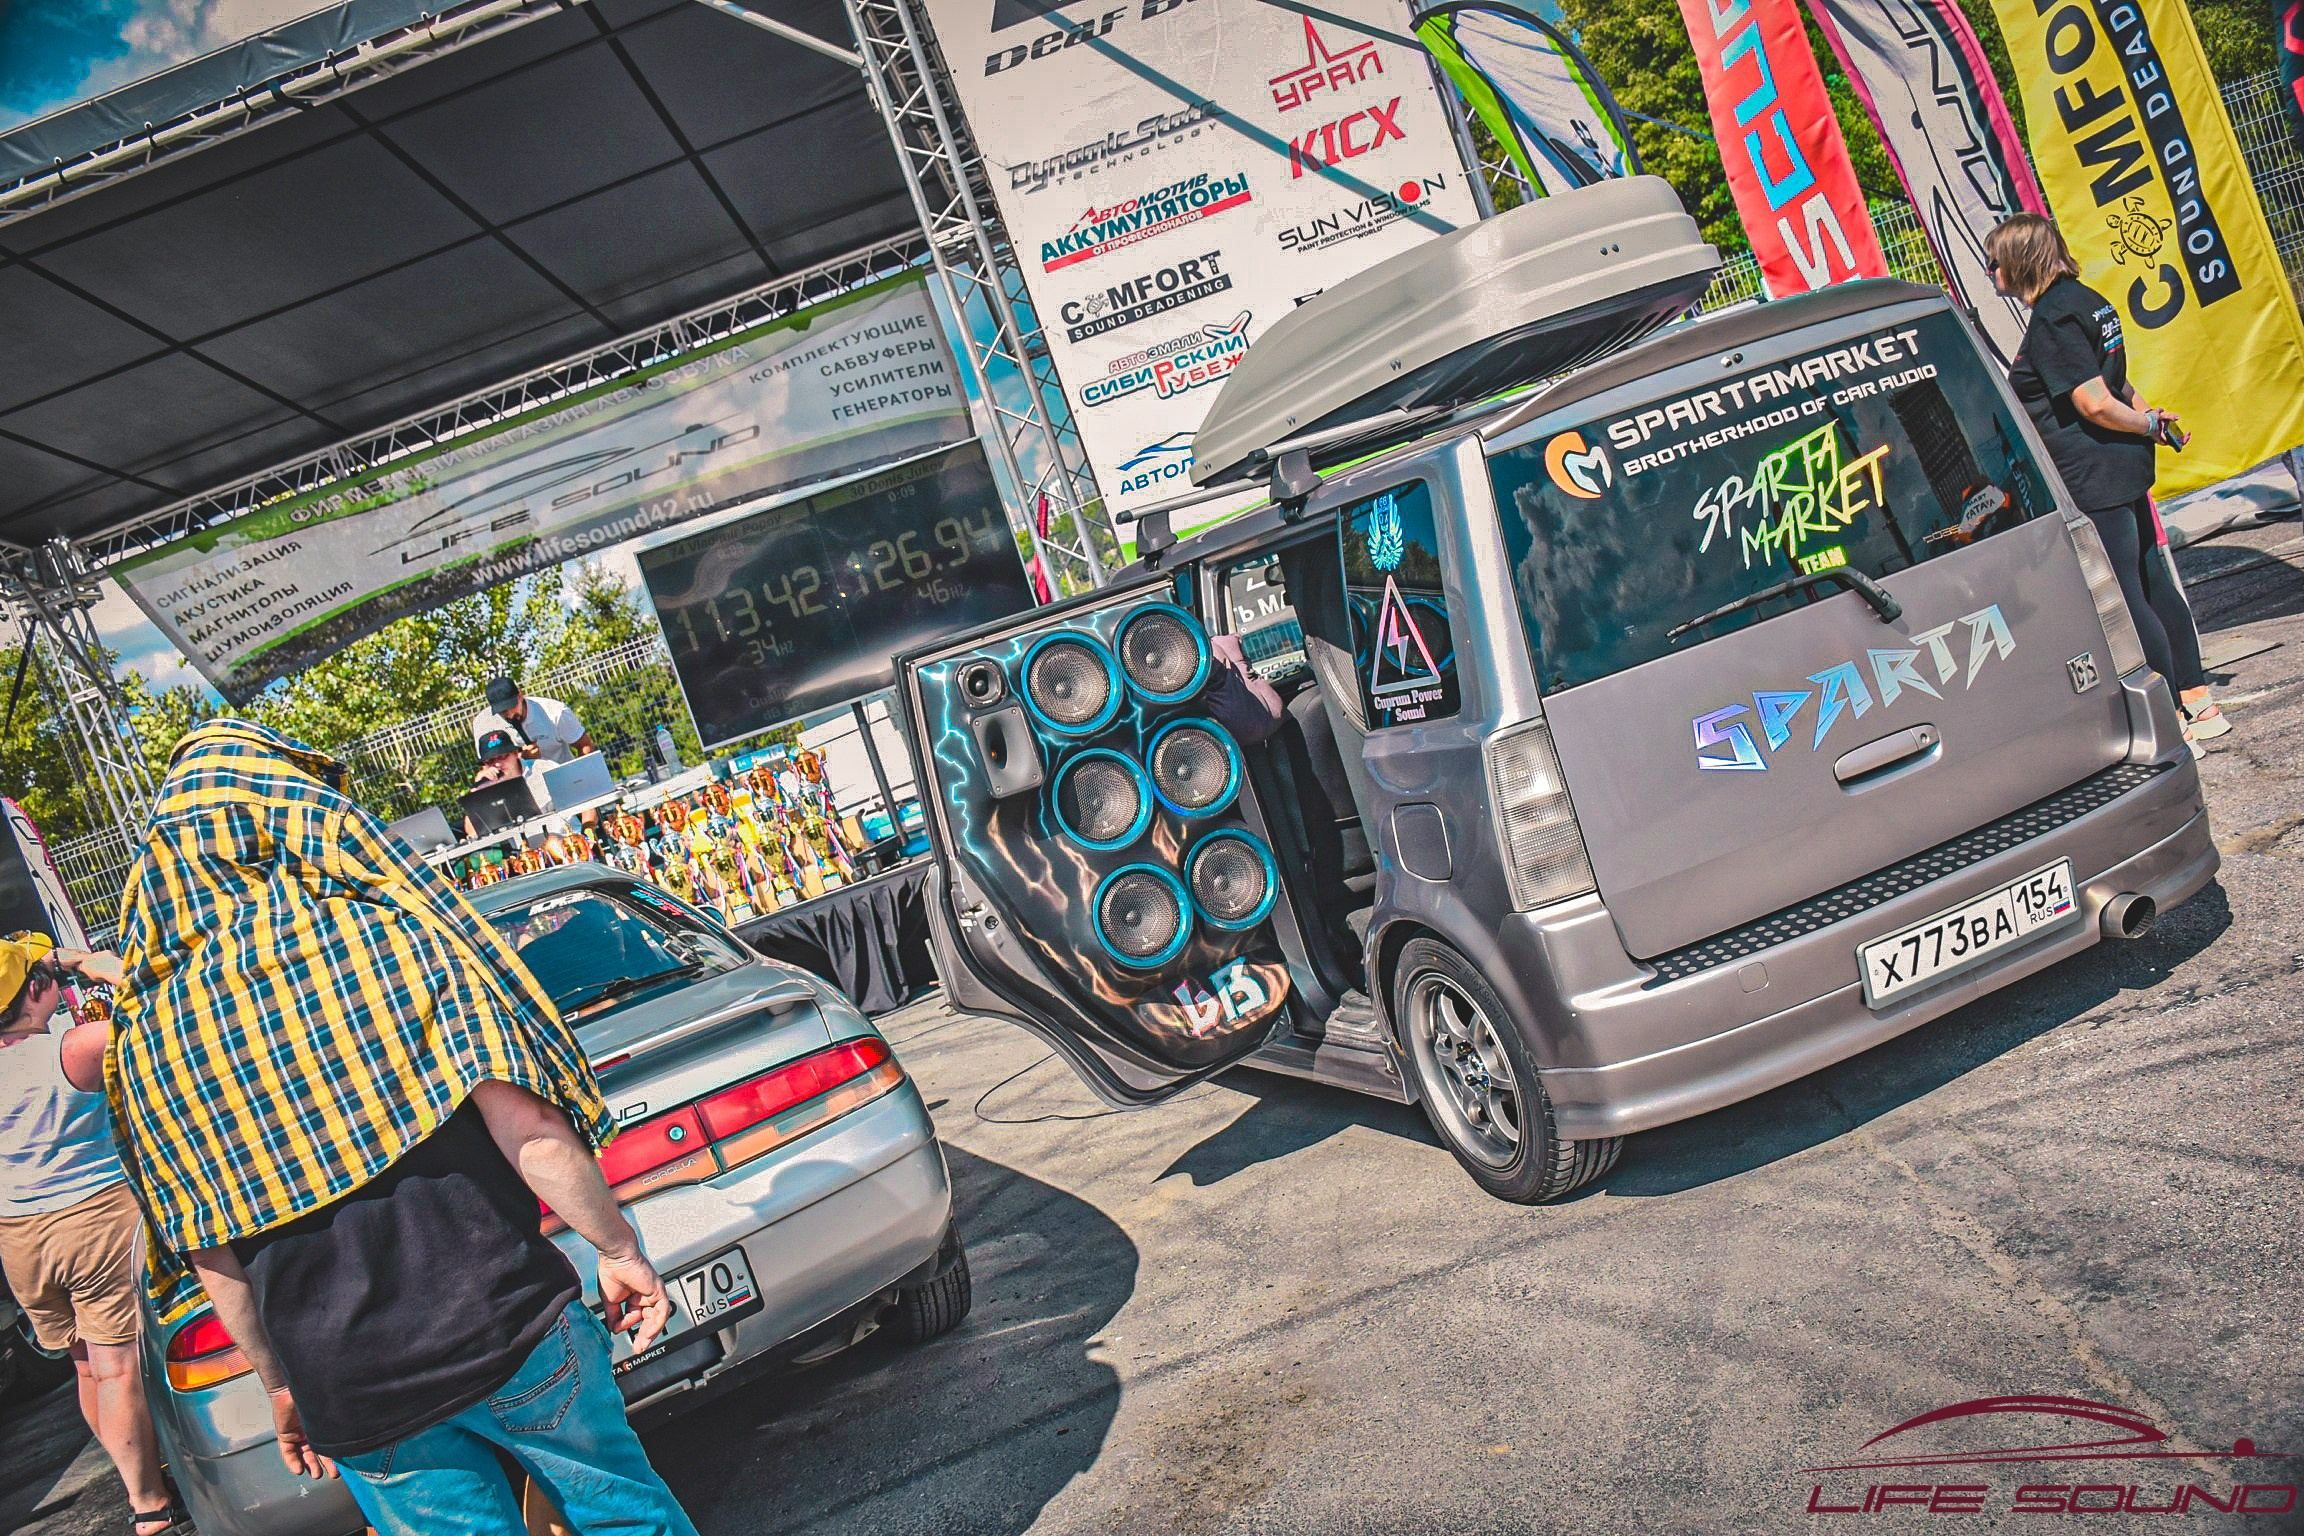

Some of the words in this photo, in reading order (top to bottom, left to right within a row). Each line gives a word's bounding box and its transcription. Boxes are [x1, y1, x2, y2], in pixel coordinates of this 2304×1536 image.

[1272, 51, 1384, 113] УРАЛ
[1874, 0, 2008, 222] OUND
[1005, 131, 1131, 195] Dynamic
[1055, 122, 1218, 186] TECHNOLOGY
[1288, 96, 1407, 180] KICX
[1041, 171, 1250, 262] АККУМУЛЯТОРЫ
[1092, 244, 1107, 256] ОТ
[1107, 210, 1204, 251] ПРОФЕССИОНАЛОВ
[1278, 213, 1341, 251] SUN
[1298, 240, 1320, 253] PAINT
[1320, 223, 1367, 245] PROTECTION
[1374, 207, 1408, 224] WINDOW
[1408, 199, 1431, 212] FILMS
[1355, 226, 1383, 241] WORLD
[2163, 136, 2227, 285] SOUND
[1074, 313, 1128, 340] SOUND
[1134, 278, 1226, 323] DEADENING
[749, 315, 928, 384] КОМПЛЕКТУЮЩИЕ
[820, 338, 937, 378] САБВУФЕРЫ
[829, 360, 945, 398] УСИЛИТЕЛИ
[1108, 331, 1203, 374] АВТОЭМАЛИ
[831, 384, 953, 421] ГЕНЕРАТОРЫ
[1606, 328, 1920, 450] SPARTAMARKET
[1622, 408, 1799, 476] BROTHERHOOD
[1802, 396, 1828, 417] OF
[1836, 382, 1878, 405] CAR
[1880, 364, 1938, 393] AUDIO
[289, 449, 462, 523] ФИРМЕННЫЙ
[467, 402, 591, 461] МАГАЗИН
[597, 345, 750, 411] АВТОЗВУКА
[401, 508, 532, 565] LIFE
[551, 425, 761, 512] SOUND
[1119, 455, 1197, 496] АВТОЛ
[1693, 418, 1840, 554] SPARTA
[471, 488, 717, 588] www.lifesound42.ru
[1741, 444, 1890, 570] MARKET
[156, 541, 303, 609] СИГНАЛИЗАЦИЯ
[847, 507, 1000, 596] 126.94
[1798, 544, 1847, 576] TEAM
[174, 578, 266, 628] АКУСТИКА
[188, 583, 300, 646] МАГНИТОЛЫ
[203, 580, 354, 664] ШУМОИЗОЛЯЦИЯ
[676, 565, 829, 652] 113.42
[1374, 691, 1412, 712] Cuprum
[1411, 687, 1443, 703] Power
[1395, 705, 1426, 722] Sound
[1692, 602, 2017, 772] SPARTA
[2014, 870, 2065, 918] 154
[2029, 906, 2054, 926] RUS
[642, 1157, 697, 1186] COROLLA
[685, 1262, 734, 1307] 70
[694, 1298, 728, 1321] RUS
[632, 1345, 667, 1367] МАРКЕТ
